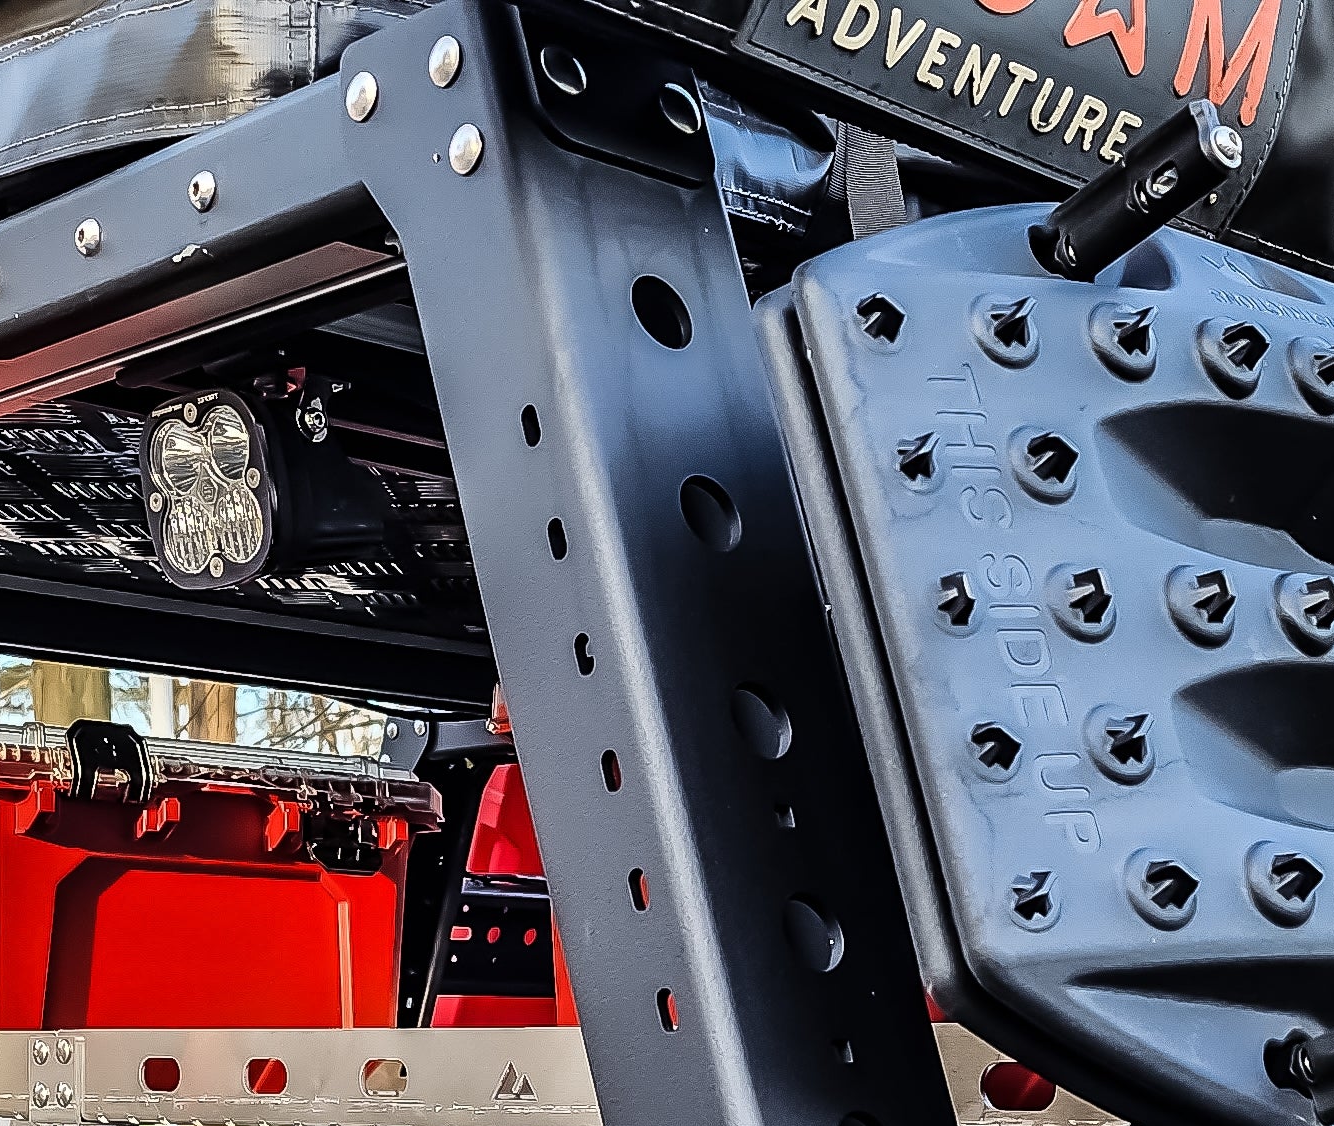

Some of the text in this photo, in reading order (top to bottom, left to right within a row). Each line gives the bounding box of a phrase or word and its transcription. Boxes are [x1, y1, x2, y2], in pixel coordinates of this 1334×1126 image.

[785, 0, 1144, 167] ADVENTURE
[925, 362, 1104, 857] THIS SIDE UP
